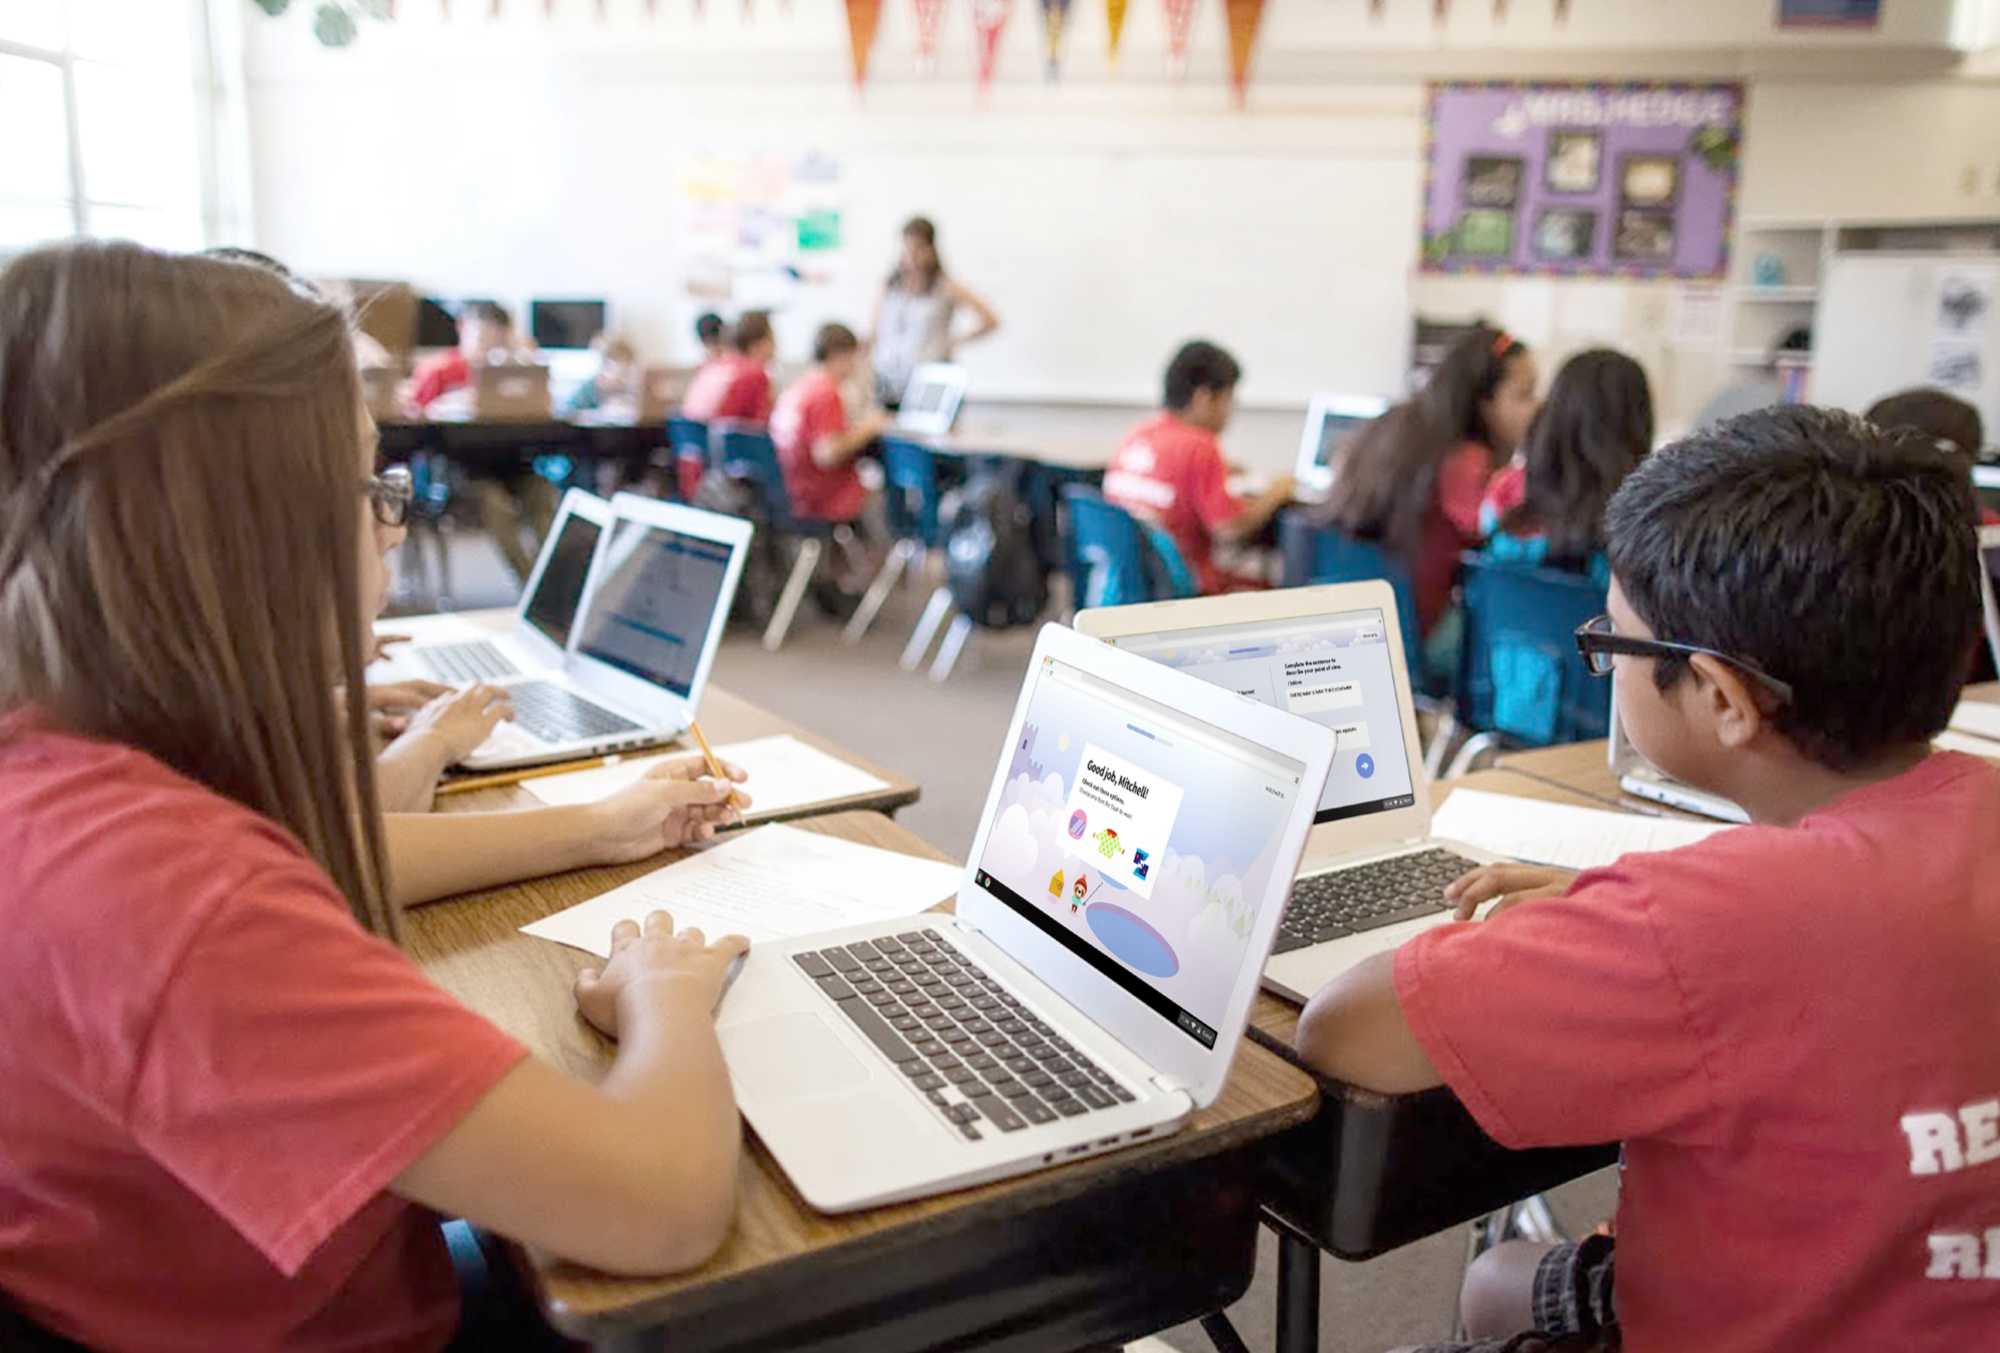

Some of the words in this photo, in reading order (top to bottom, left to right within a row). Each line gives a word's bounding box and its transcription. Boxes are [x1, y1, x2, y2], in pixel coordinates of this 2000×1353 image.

[1285, 661, 1304, 669] Complete
[1082, 778, 1093, 788] Check
[1100, 787, 1110, 797] these
[1110, 793, 1125, 805] options.
[1087, 760, 1106, 778] Good
[1103, 767, 1117, 786] job,
[1118, 775, 1150, 799] Mitchell!
